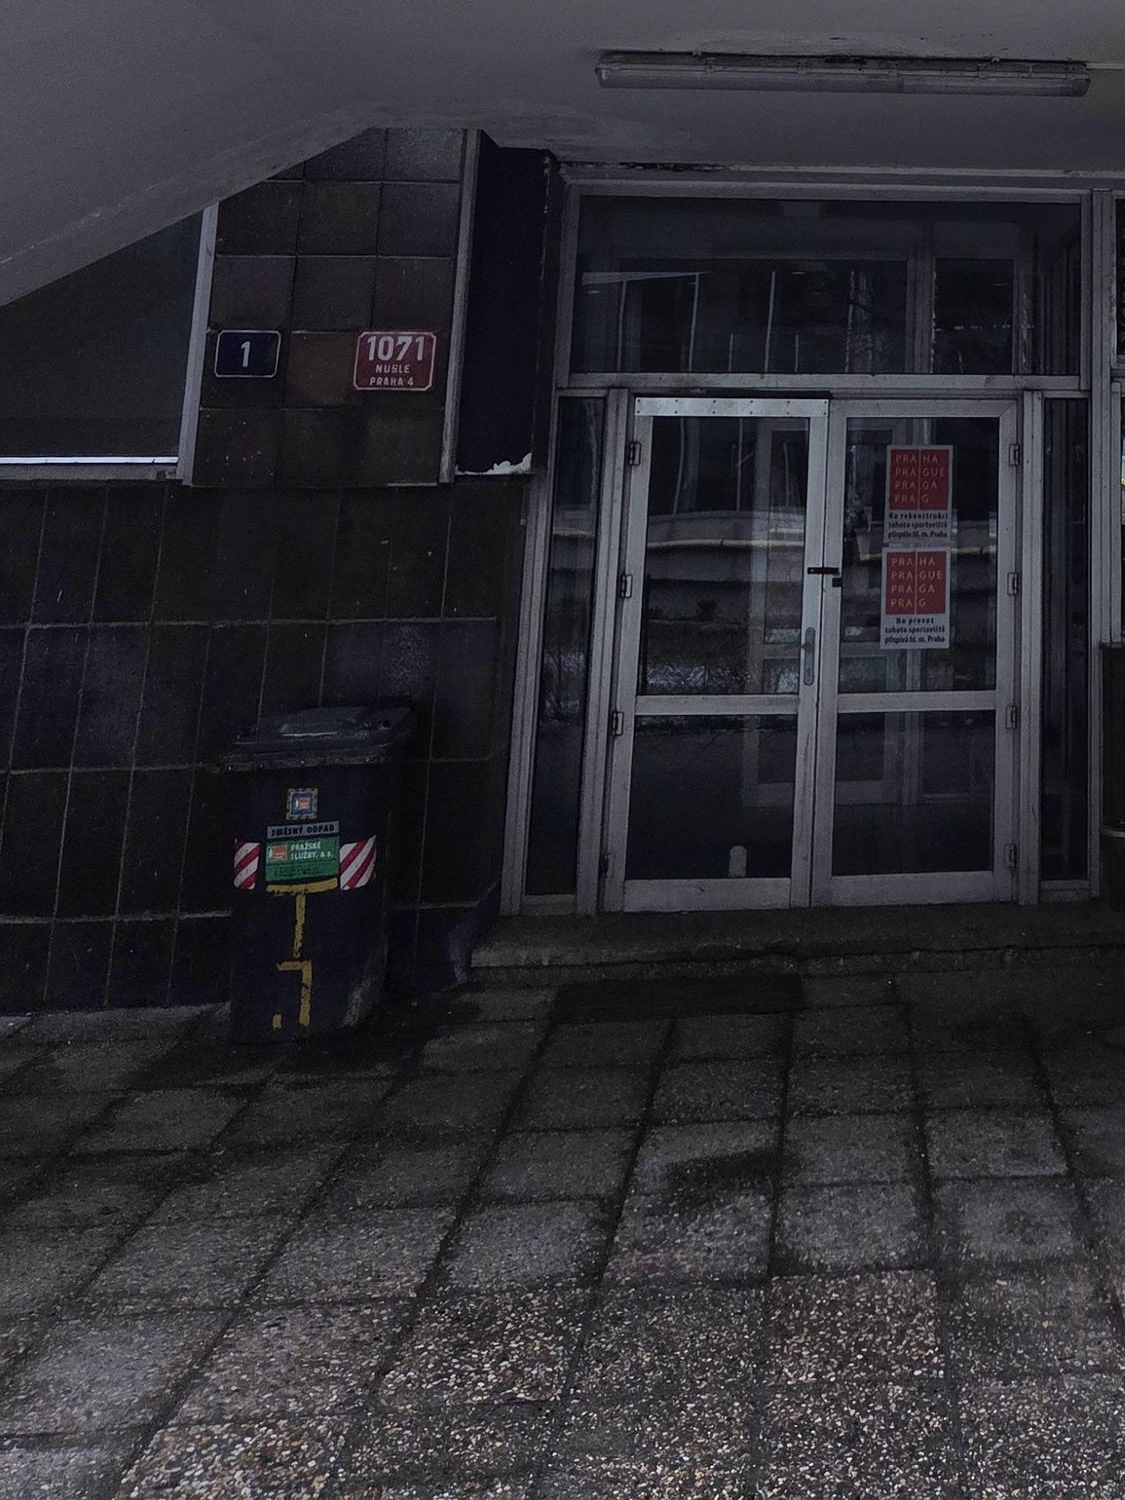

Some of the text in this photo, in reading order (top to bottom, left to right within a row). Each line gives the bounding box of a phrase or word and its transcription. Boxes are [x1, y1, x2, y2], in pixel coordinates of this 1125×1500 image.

[367, 335, 425, 361] 1071
[240, 341, 251, 368] 1
[375, 363, 411, 374] NUSLE
[369, 376, 414, 386] PRAHA 4
[306, 823, 335, 834] ODPAD
